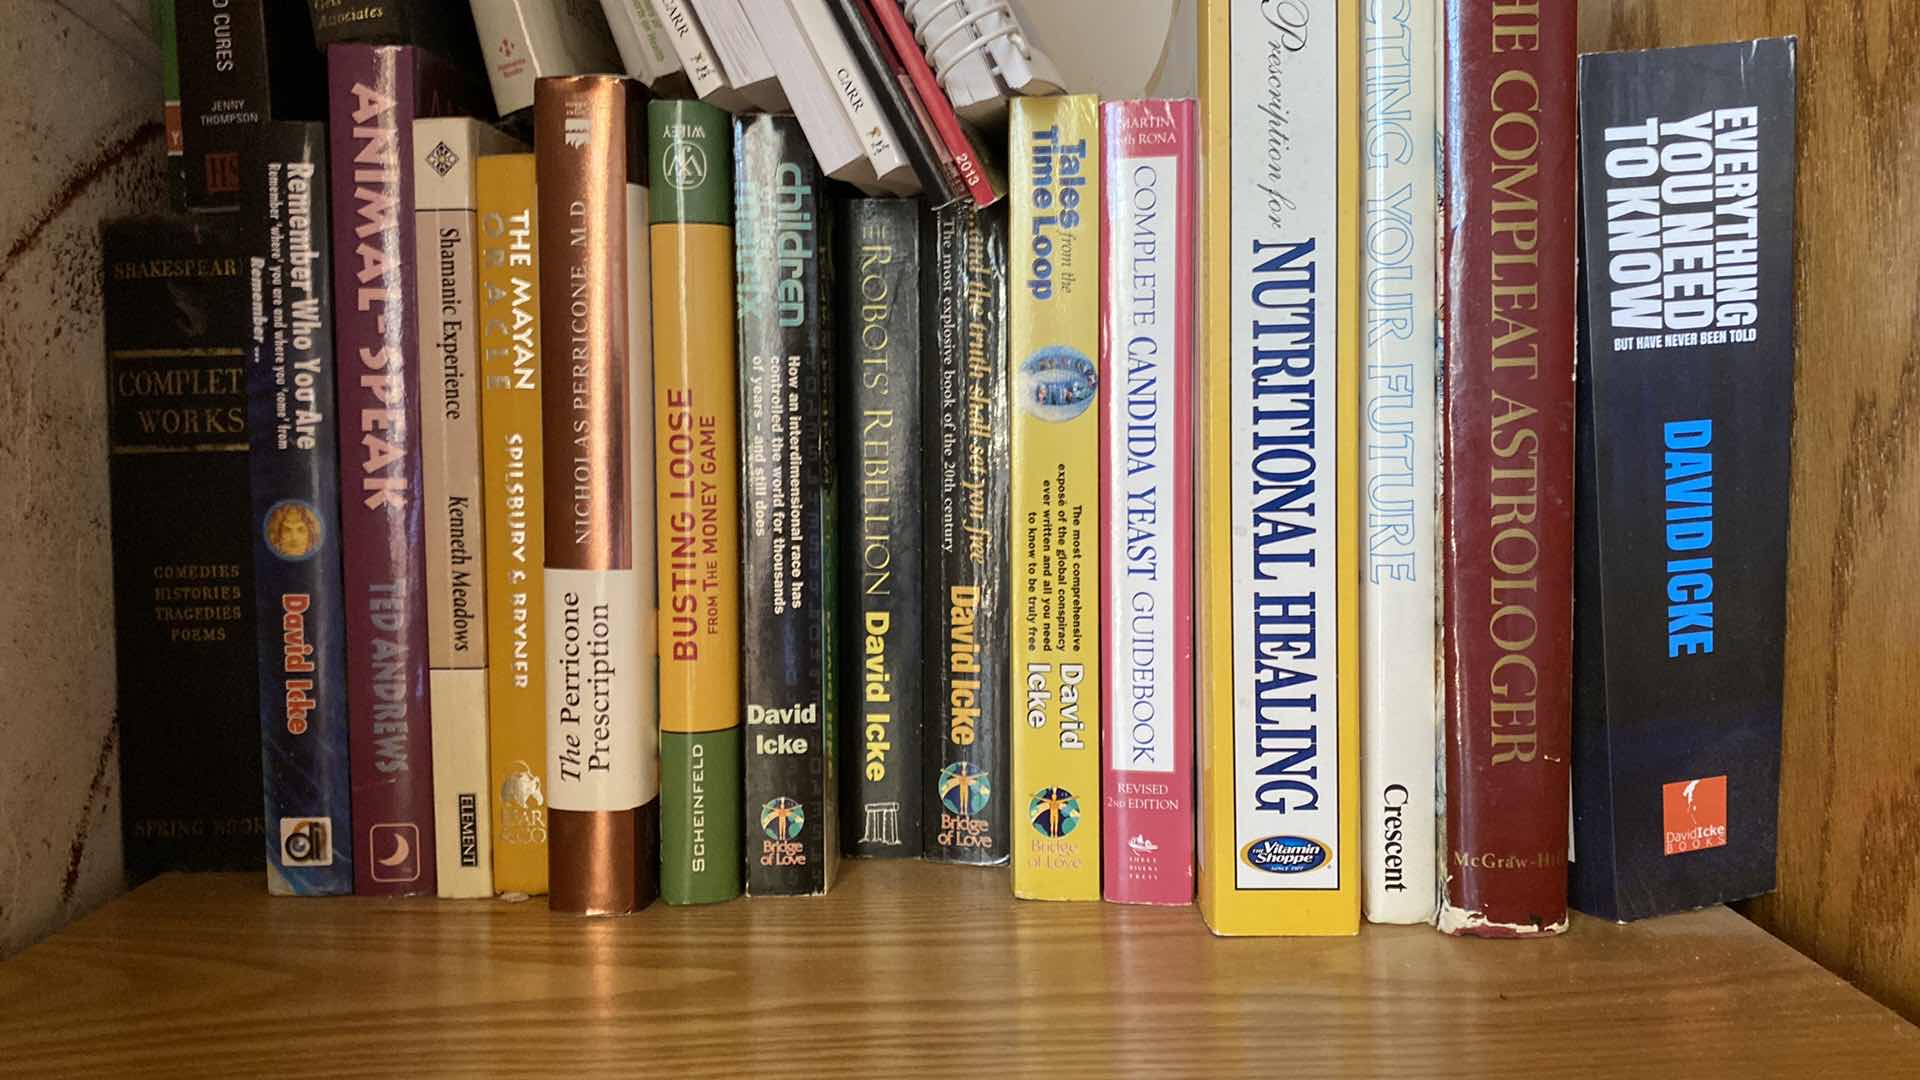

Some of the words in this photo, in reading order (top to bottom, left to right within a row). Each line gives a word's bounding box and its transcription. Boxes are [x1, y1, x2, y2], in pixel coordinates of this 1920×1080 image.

[213, 14, 233, 72] CURES
[211, 99, 245, 112] JENNY
[836, 67, 864, 112] CARR
[1257, 0, 1309, 184] Prescription
[200, 112, 258, 126] THOMPSON
[664, 125, 706, 138] WILEY
[1139, 132, 1176, 145] RONA
[955, 151, 980, 187] 2013
[1032, 125, 1059, 209] Time
[1604, 117, 1660, 179] TO
[1660, 110, 1714, 205] YOU
[268, 162, 284, 219] Remember
[1059, 138, 1087, 228] Tales
[287, 162, 320, 290] Remember
[1257, 184, 1296, 229] for
[1490, 70, 1541, 381] COMPLEAT
[1714, 105, 1759, 328] EVERYTHING
[509, 209, 532, 267] THE
[943, 219, 956, 249] The
[1056, 230, 1076, 268] from
[1133, 165, 1157, 327] COMPLETE
[269, 265, 282, 286] you
[439, 227, 462, 316] Shamanic
[943, 254, 953, 293] most
[1027, 215, 1058, 299] Loop
[1366, 183, 1414, 345] YOUR
[1606, 185, 1663, 330] KNOW
[1661, 211, 1715, 330] NEED
[250, 256, 269, 343] Remember
[483, 212, 512, 390] ORACLE
[968, 281, 992, 319] the
[1061, 272, 1076, 293] the
[273, 307, 288, 329] and
[292, 297, 322, 350] Who
[510, 277, 536, 390] MAYAN
[941, 297, 956, 366] explosive
[1613, 337, 1635, 351] BUT
[1636, 334, 1663, 350] HAVE
[1664, 332, 1698, 347] NEVER
[1700, 330, 1728, 345] BEEN
[1729, 328, 1757, 343] TOLD
[274, 329, 289, 363] where
[751, 355, 765, 372] of
[968, 320, 992, 379] truth
[272, 365, 285, 385] you
[294, 357, 321, 402] You
[436, 319, 465, 420] Experience
[788, 355, 801, 388] How
[943, 370, 956, 408] book
[750, 376, 763, 418] years
[770, 356, 784, 433] controlled
[789, 393, 800, 412] an
[968, 383, 992, 438] shall
[1127, 336, 1158, 477] CANDIDA
[1251, 237, 1317, 581] NUTRITIONAL
[139, 408, 245, 433] WORKS
[277, 423, 292, 450] from
[295, 409, 323, 450] Are
[943, 412, 957, 431] of
[667, 388, 696, 500] LOOSE
[700, 415, 717, 474] GAME
[753, 435, 766, 463] and
[771, 436, 784, 462] the
[943, 434, 957, 457] the
[572, 422, 591, 546] NICHOLAS
[754, 467, 767, 496] still
[772, 466, 785, 508] world
[789, 416, 804, 541] interdimensional
[943, 461, 957, 493] 20th
[1043, 479, 1051, 507] ever
[1366, 364, 1416, 585] FUTURE
[1664, 419, 1714, 551] DAVID
[504, 432, 528, 563] SPILSBURY
[755, 500, 767, 537] does
[863, 409, 892, 597] REBELLION
[960, 478, 985, 520] you
[1028, 511, 1037, 524] to
[1057, 510, 1067, 522] of
[1073, 505, 1083, 526] The
[448, 496, 473, 564] Kenneth
[701, 484, 719, 556] MONEY
[772, 512, 786, 534] for
[941, 498, 954, 553] century
[961, 518, 992, 565] free
[1043, 509, 1053, 552] written
[1057, 526, 1067, 546] the
[1127, 487, 1157, 582] YEAST
[791, 545, 802, 577] race
[1028, 528, 1037, 559] know
[1043, 555, 1052, 576] and
[1073, 530, 1082, 559] most
[153, 564, 241, 579] COMEDIES
[671, 511, 698, 662] BUSTING
[773, 538, 787, 615] thousands
[1028, 562, 1037, 575] to
[1028, 578, 1038, 592] be
[1043, 580, 1052, 595] all
[1056, 549, 1068, 585] global
[1489, 392, 1541, 768] ASTROLOGER
[153, 584, 242, 601] HISTORIES
[153, 604, 242, 621] TRAGEDIES
[368, 583, 406, 633] TED
[450, 568, 476, 654] Meadows
[791, 580, 804, 609] has
[1026, 596, 1038, 623] truly
[1041, 597, 1051, 619] you
[1071, 563, 1083, 652] comprehensive
[1666, 559, 1715, 659] ICKE
[170, 625, 227, 642] POEMS
[282, 592, 316, 673] David
[707, 597, 719, 635] FROM
[950, 585, 981, 674] David
[1043, 623, 1052, 652] need
[1056, 588, 1068, 651] conspiracy
[560, 592, 580, 729] Perricone
[864, 611, 891, 702] David
[1028, 626, 1038, 652] free
[588, 601, 616, 774] Prescription
[1026, 662, 1052, 730] Icke
[1131, 591, 1155, 764] GUIDEBOOK
[285, 678, 317, 735] Icke
[371, 638, 409, 774] ANDREWS
[747, 703, 817, 725] David
[950, 680, 982, 746] Icke
[1060, 663, 1086, 750] David
[1252, 591, 1319, 815] HEALING
[560, 736, 582, 783] The
[755, 734, 809, 755] Icke
[864, 714, 891, 783] Icke
[692, 744, 706, 872] SCHEINFELD
[1118, 783, 1168, 795] REVISED
[1128, 798, 1179, 810] EDITION
[459, 795, 478, 867] ELEMENT
[937, 832, 953, 847] of
[956, 832, 992, 849] Love
[941, 813, 989, 836] Bridge
[1382, 782, 1410, 893] Crescent
[1666, 824, 1725, 843] DavidIcke
[1666, 837, 1727, 855] BOOKS
[761, 855, 773, 866] of
[776, 854, 806, 866] Love
[763, 839, 803, 856] Bridge
[1255, 852, 1313, 865] Shoppe
[1264, 840, 1321, 854] Vitamin
